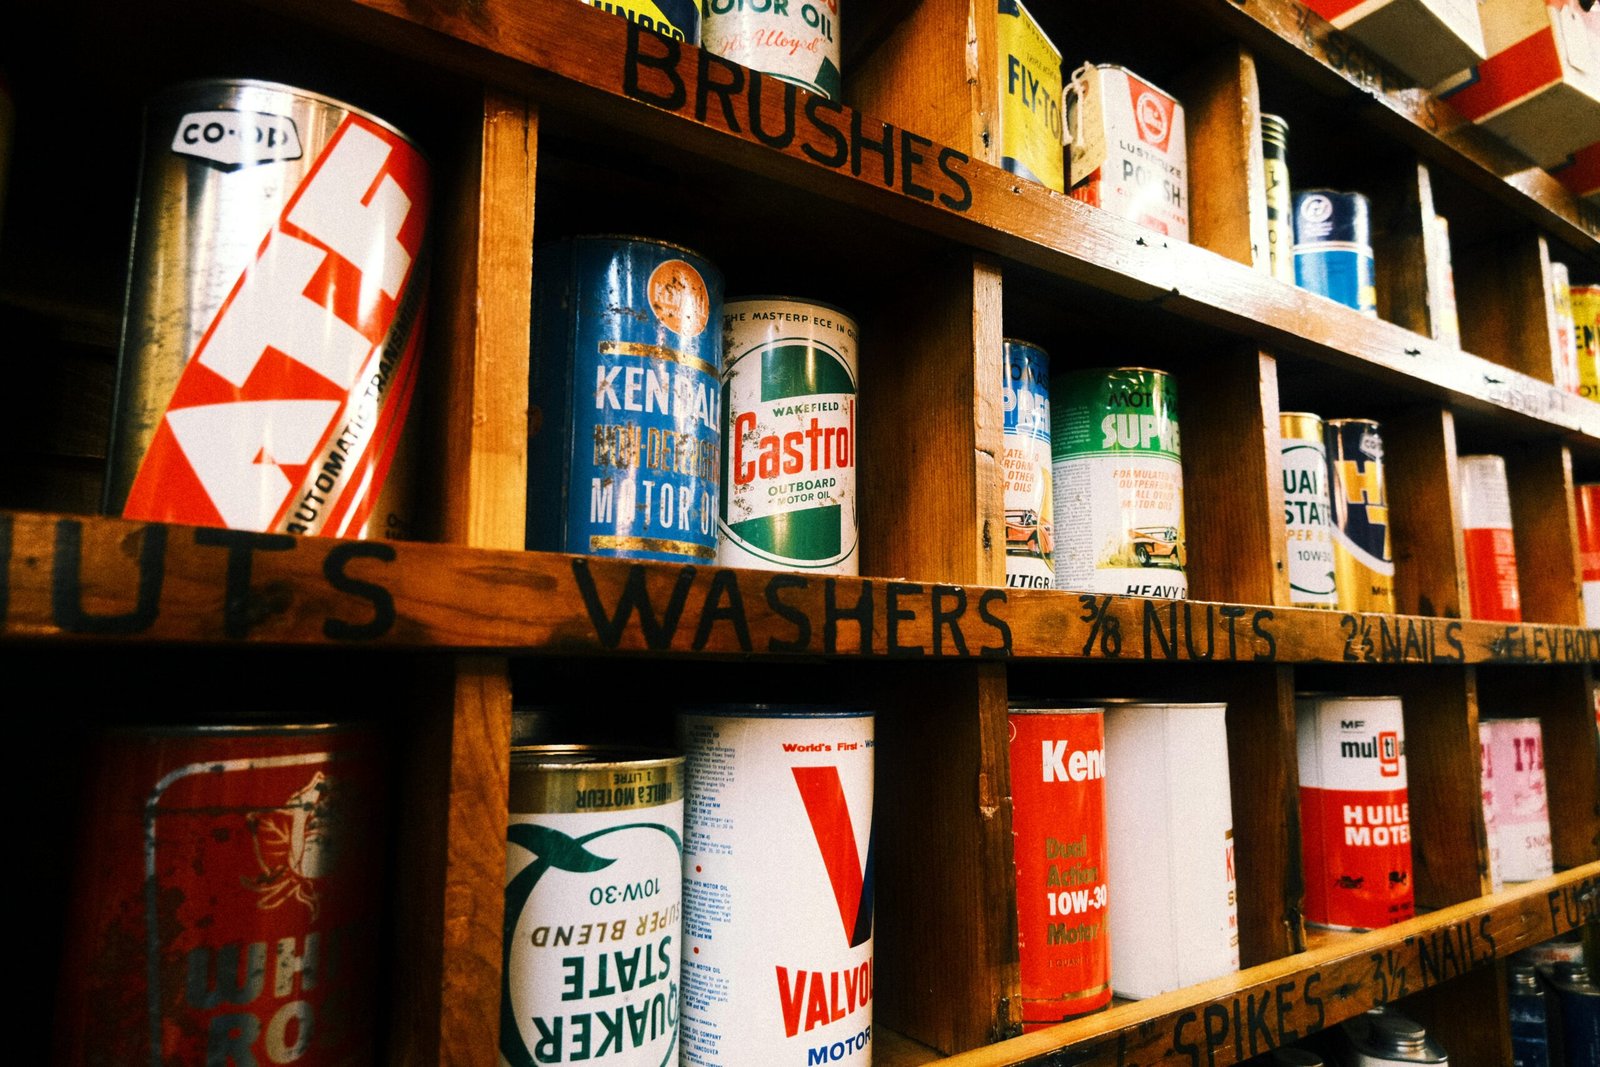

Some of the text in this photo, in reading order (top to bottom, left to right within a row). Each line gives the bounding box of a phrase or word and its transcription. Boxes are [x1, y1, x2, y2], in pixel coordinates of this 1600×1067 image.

[801, 4, 833, 43] OIL
[1008, 54, 1061, 140] FLY-TO
[623, 22, 972, 211] BRUSHES
[1123, 159, 1181, 208] POSH
[165, 121, 412, 532] ATF
[836, 323, 846, 333] IN
[773, 402, 839, 417] WAKEFIELD
[1107, 391, 1153, 408] MOT
[734, 400, 855, 486] Castrol
[768, 477, 836, 496] OUTBOARD
[778, 490, 831, 506] MOTOR OIL
[1013, 481, 1032, 493] OILS
[1135, 489, 1151, 499] ALL
[590, 477, 692, 531] MOTOR
[0, 514, 397, 642] UTS
[571, 559, 1013, 656] WASHERS
[1143, 600, 1276, 661] NUTS
[1381, 616, 1465, 664] NAILS
[1340, 720, 1365, 729] MF
[782, 743, 832, 752] World's
[837, 742, 858, 751] First
[613, 772, 642, 785] LITRE
[575, 787, 636, 809] MOTEUR
[1343, 802, 1409, 826] HUILE
[1045, 834, 1087, 859] Dual
[1344, 824, 1411, 847] MOTE
[1047, 862, 1097, 887] Action
[1047, 884, 1107, 916] 10W-30
[530, 919, 628, 948] BLEND
[636, 901, 680, 938] SUPER
[1047, 922, 1099, 946] Motor
[561, 935, 673, 1002] STATE
[1173, 971, 1327, 1067] SPIKES
[1418, 915, 1497, 989] NAILS
[532, 979, 679, 1064] QUAKER
[808, 1025, 871, 1067] MOTOR
